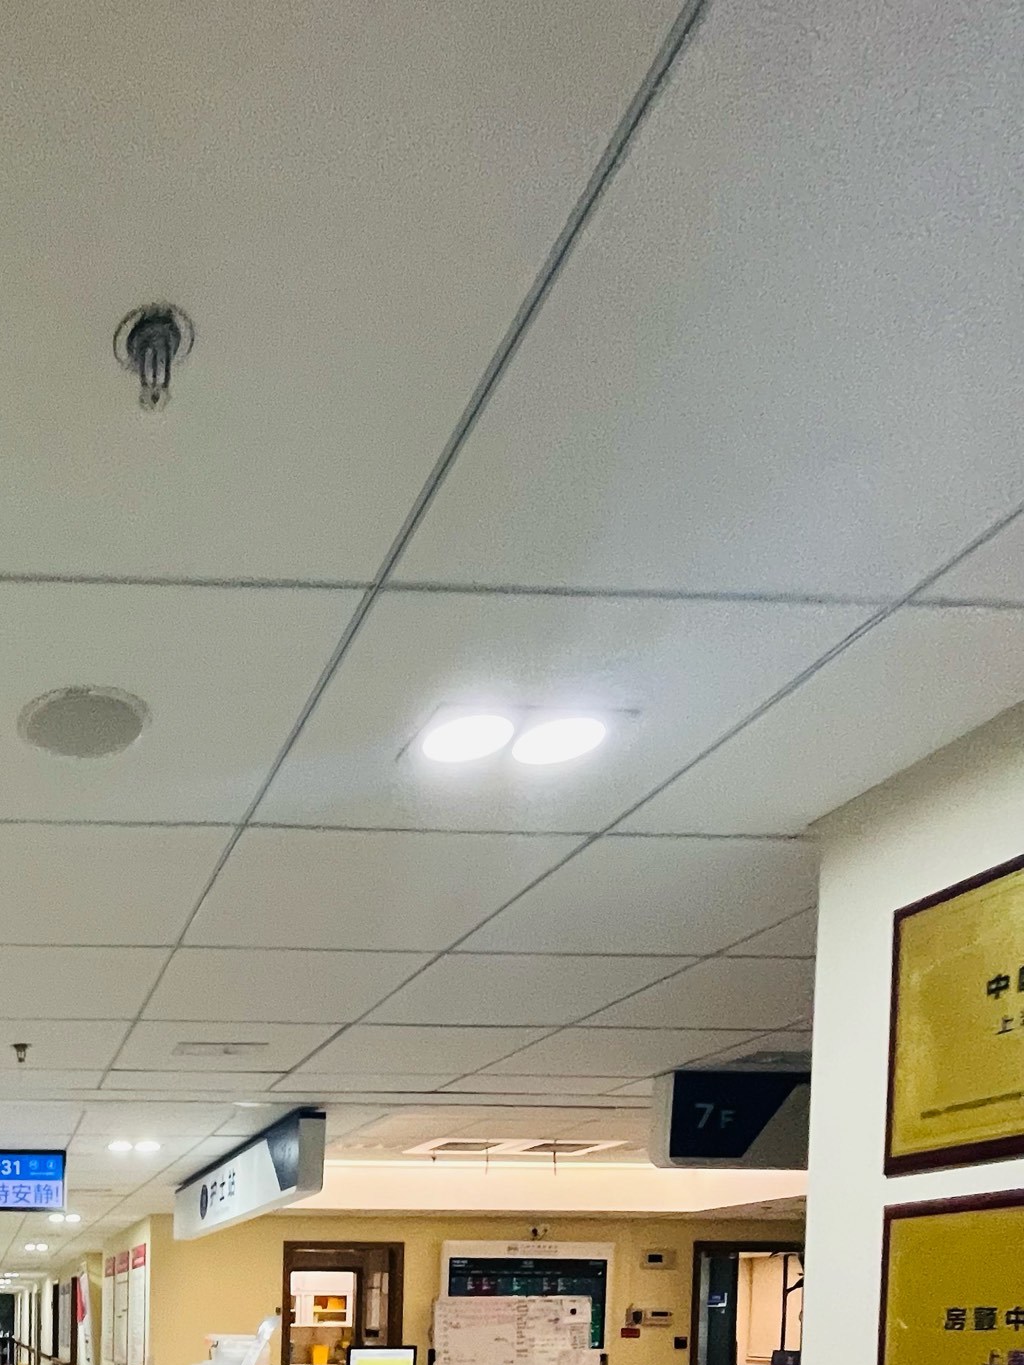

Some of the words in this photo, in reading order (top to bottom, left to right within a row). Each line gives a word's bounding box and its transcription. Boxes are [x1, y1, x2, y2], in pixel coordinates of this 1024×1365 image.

[987, 966, 1024, 999] 中
[996, 1011, 1024, 1035] 上
[694, 1103, 736, 1129] 7F
